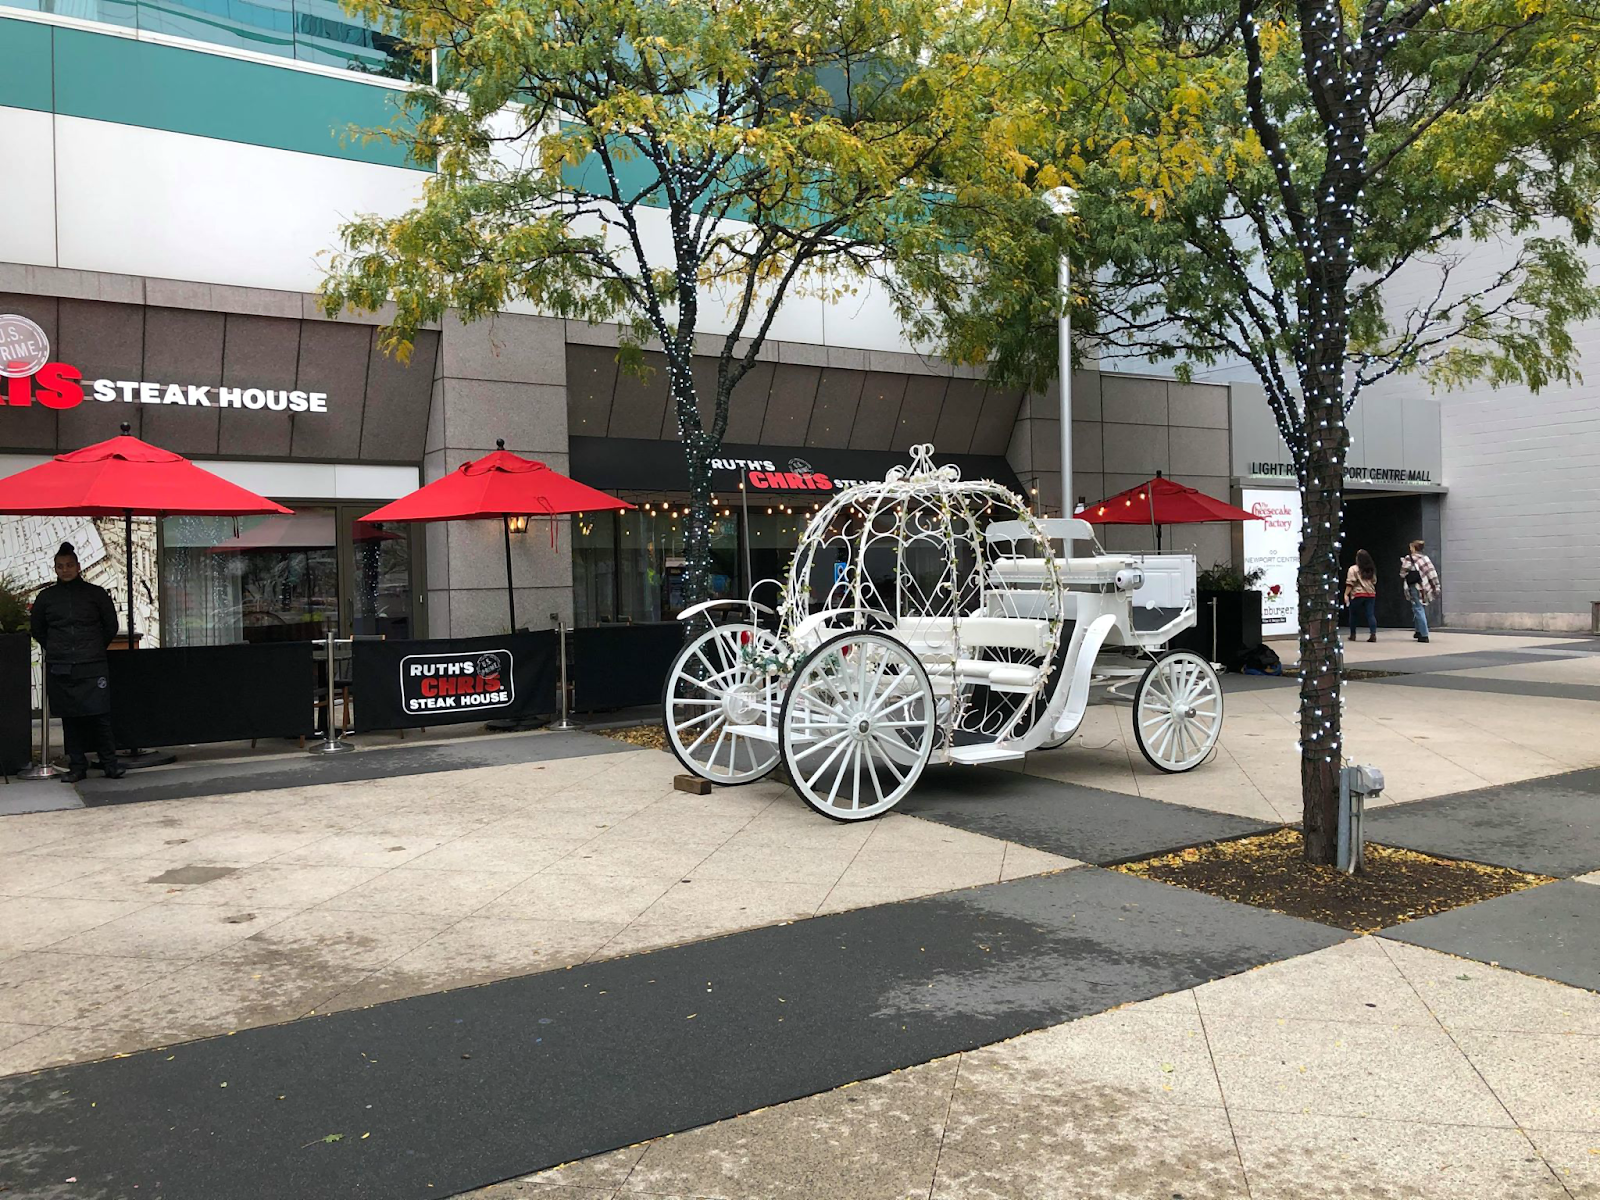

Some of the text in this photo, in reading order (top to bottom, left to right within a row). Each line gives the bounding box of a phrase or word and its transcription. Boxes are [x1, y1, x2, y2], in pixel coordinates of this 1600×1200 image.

[0, 341, 38, 361] RIME
[93, 379, 212, 407] STEAK
[219, 387, 328, 412] HOUSE
[711, 458, 776, 471] RUTH'S
[1252, 462, 1284, 476] LIGHT
[1343, 466, 1368, 479] PORT
[1370, 468, 1406, 481] CENTRE
[1408, 470, 1431, 482] MALL
[749, 471, 833, 490] CHRIS
[1252, 502, 1292, 516] Cheesecake
[1263, 515, 1292, 532] Factory
[1245, 556, 1276, 564] NEWPORT
[1263, 606, 1295, 617] nburger
[410, 661, 475, 676] RUTH'S
[409, 691, 509, 710] STEAK HOUSE
